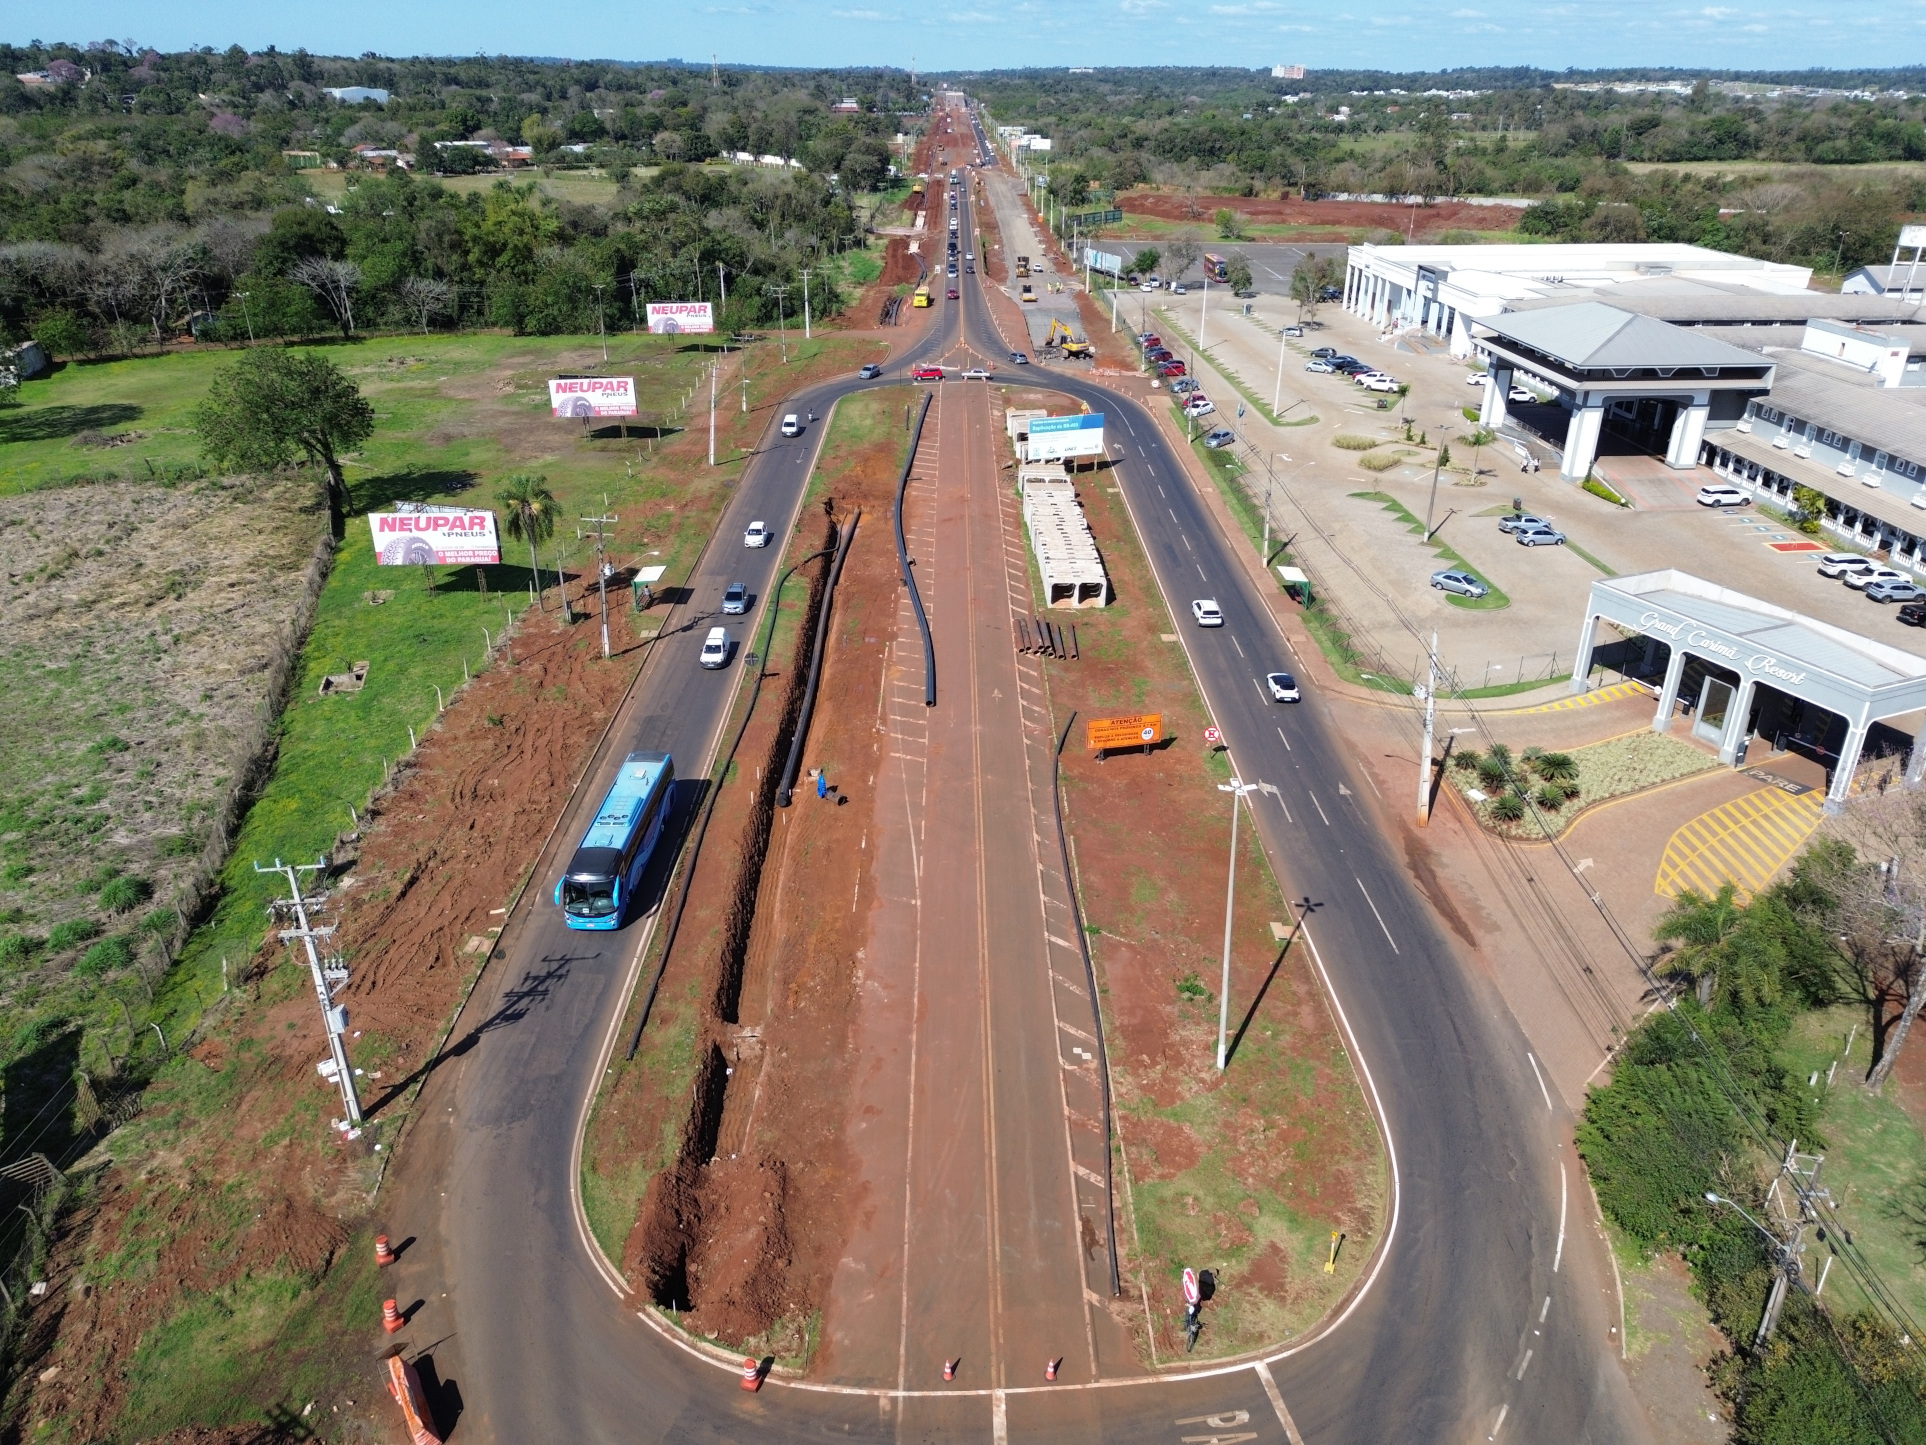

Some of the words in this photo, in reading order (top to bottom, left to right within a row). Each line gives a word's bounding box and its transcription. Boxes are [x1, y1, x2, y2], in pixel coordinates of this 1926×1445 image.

[651, 305, 708, 315] NEUPAR
[555, 380, 629, 394] NEUPAR
[379, 515, 486, 533] NEUPAR
[474, 549, 498, 558] PREÇO
[1633, 611, 1697, 642] Grand
[1687, 630, 1742, 661] Carimã
[1744, 654, 1806, 686] Resort
[1110, 717, 1143, 726] ATENÇÃO
[1749, 769, 1802, 793] PARE
